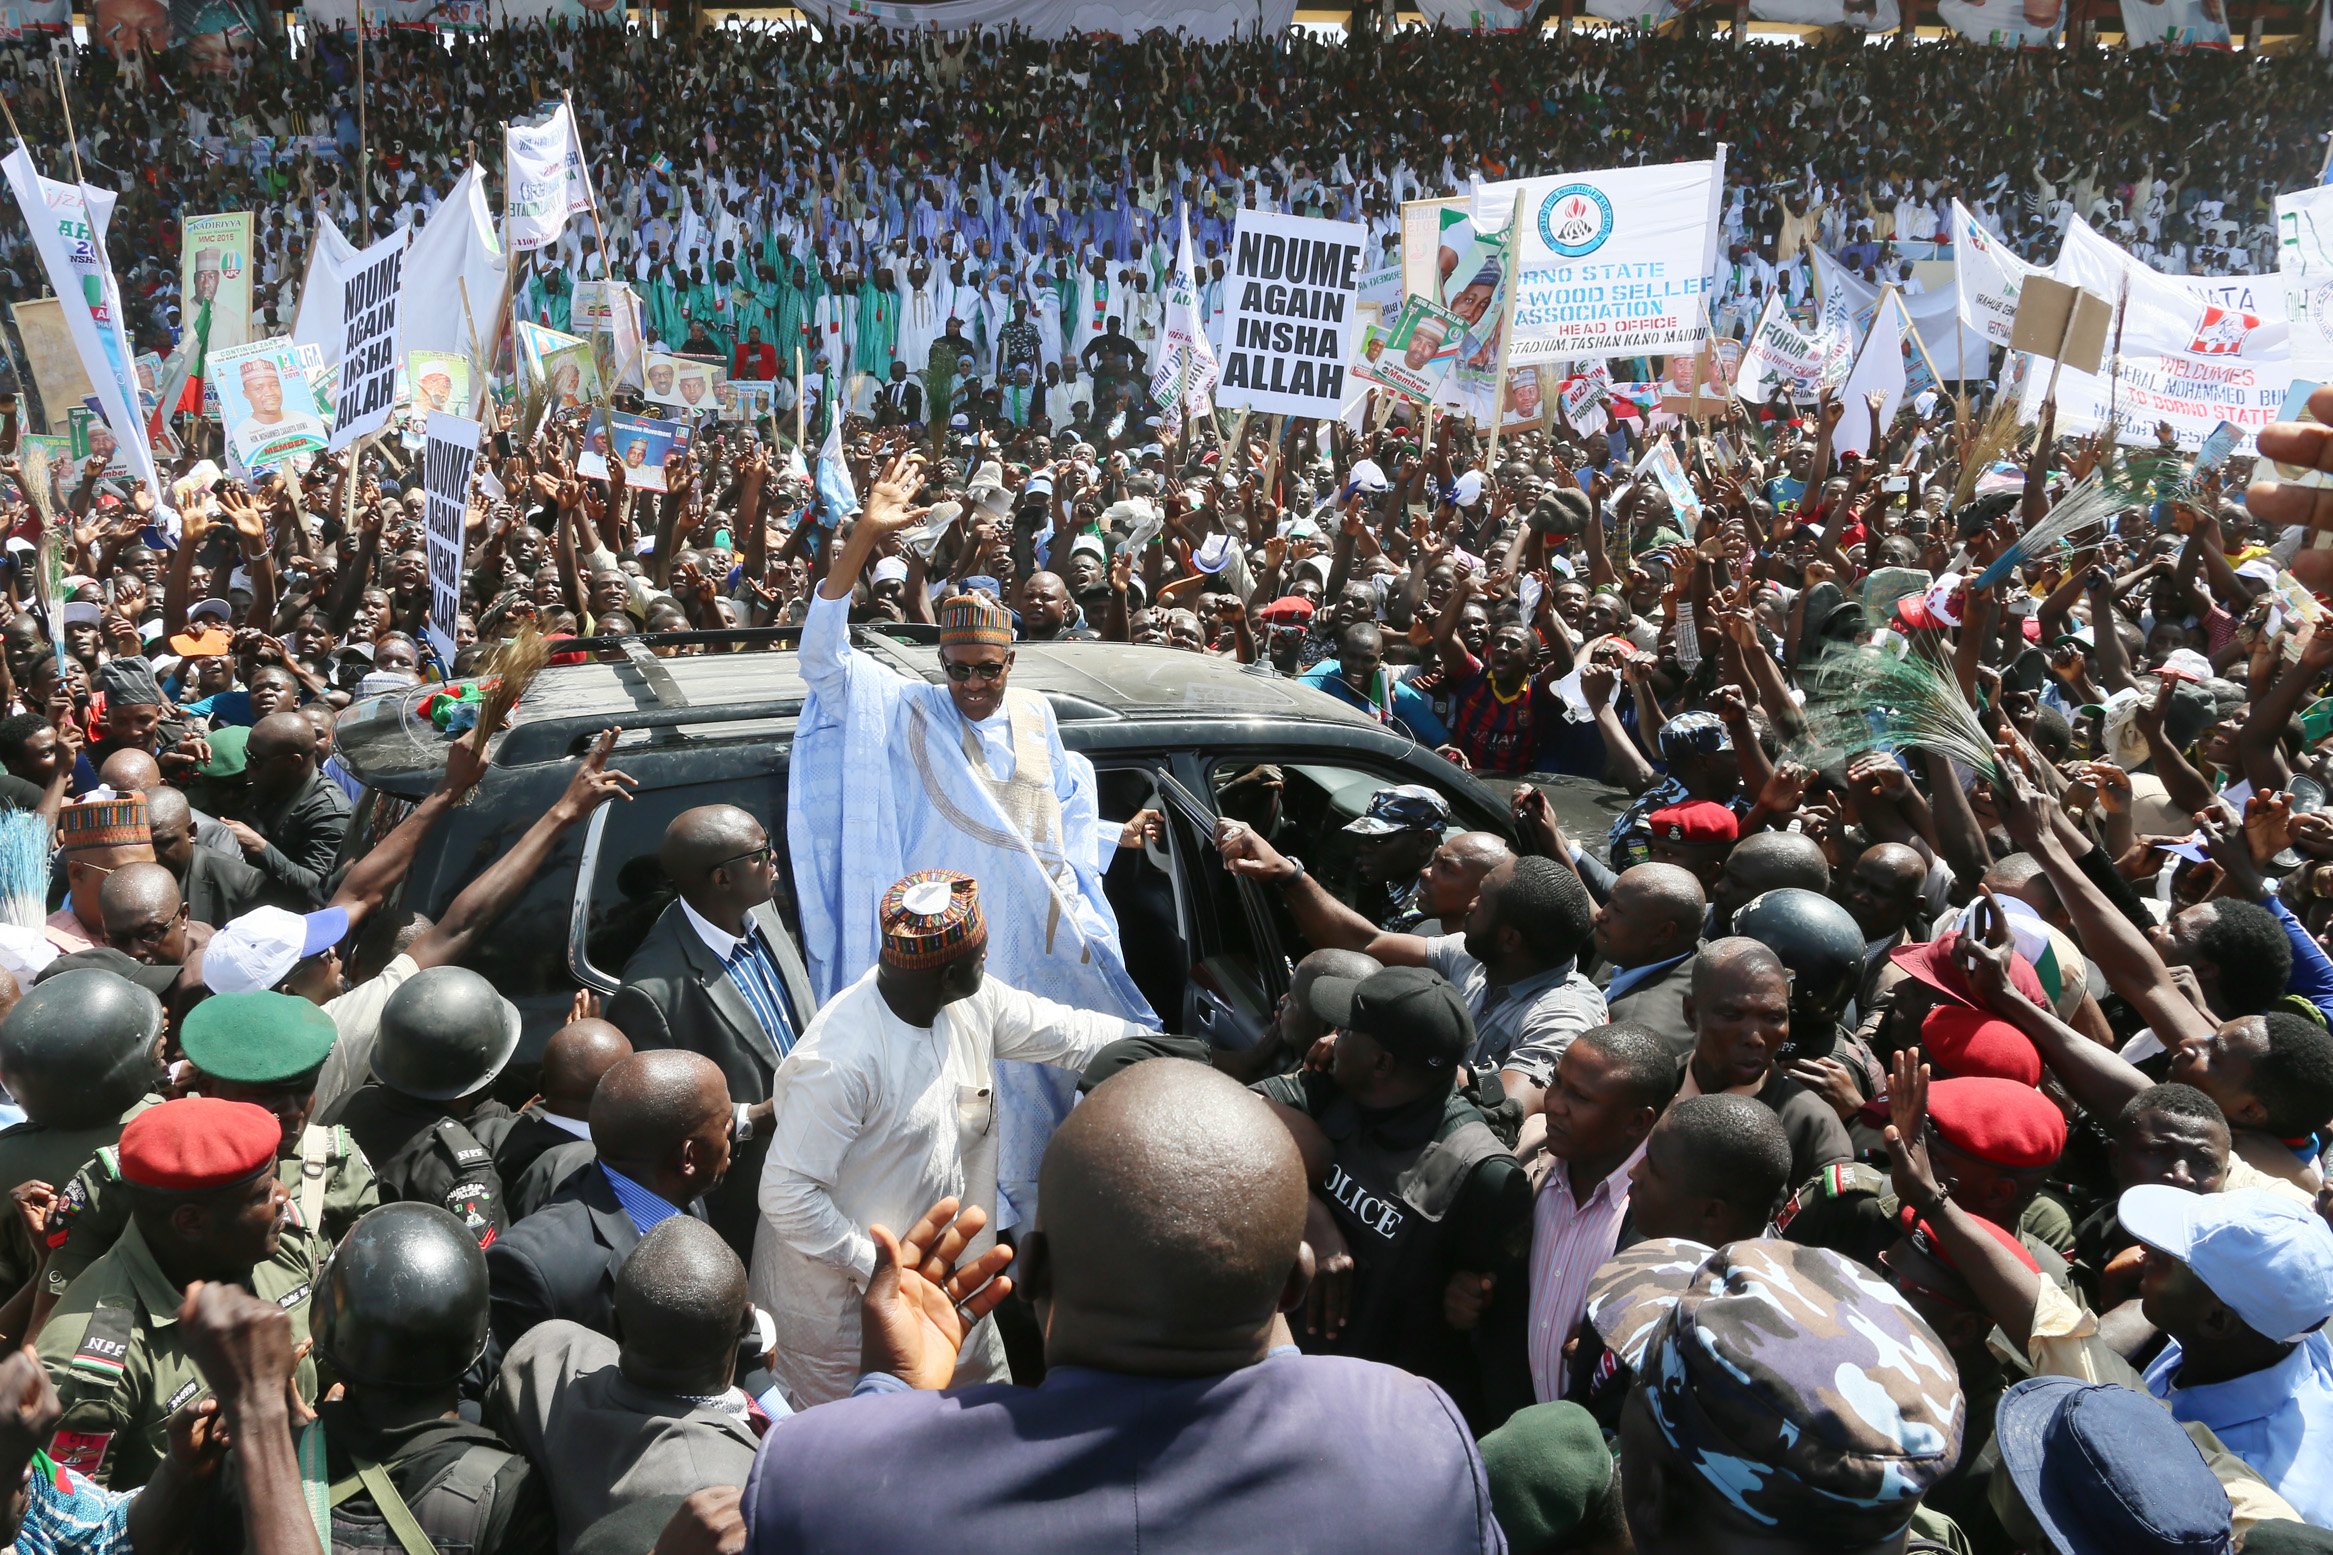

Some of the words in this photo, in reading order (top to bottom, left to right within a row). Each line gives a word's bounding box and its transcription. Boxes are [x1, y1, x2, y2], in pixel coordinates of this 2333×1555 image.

[193, 220, 241, 231] KADIRIYYA
[217, 233, 235, 242] 2015
[225, 270, 239, 278] APC
[1236, 231, 1360, 290] NDUME
[1582, 262, 1665, 281] STATE
[344, 247, 404, 324] NDUME
[1529, 286, 1605, 307] WOOD
[2187, 285, 2256, 312] NATA
[1240, 281, 1345, 323] AGAIN
[1414, 296, 1428, 308] 2015
[1445, 311, 1465, 327] ALLAH
[1514, 300, 1663, 327] ASSOCIATION
[345, 299, 395, 355] AGAIN
[1236, 318, 1338, 359] INSHA
[1559, 322, 1607, 336] HEAD
[1615, 316, 1677, 332] OFFICE
[1624, 332, 1660, 347] KANO
[220, 343, 259, 357] CONTINUE
[1750, 343, 1772, 361] HEAD
[1759, 321, 1810, 360] FORUM
[343, 336, 392, 391] INSHA
[1222, 352, 1344, 399] ALLAH
[2159, 354, 2256, 386] WELCOMES
[1387, 367, 1428, 393] Member
[2164, 378, 2245, 405] MOHAMMED
[2127, 387, 2147, 404] TO
[2153, 395, 2208, 418] BORNO
[2213, 407, 2276, 425] STATE
[643, 426, 672, 438] Movement
[264, 438, 308, 455] MEMBER
[426, 437, 474, 504] NDUME
[429, 497, 460, 546] AGAIN
[429, 539, 456, 590] INSHA
[1779, 1042, 1796, 1053] PF
[457, 1149, 483, 1161] NPF
[446, 1183, 486, 1201] NIGERIA
[84, 1336, 126, 1358] NPF
